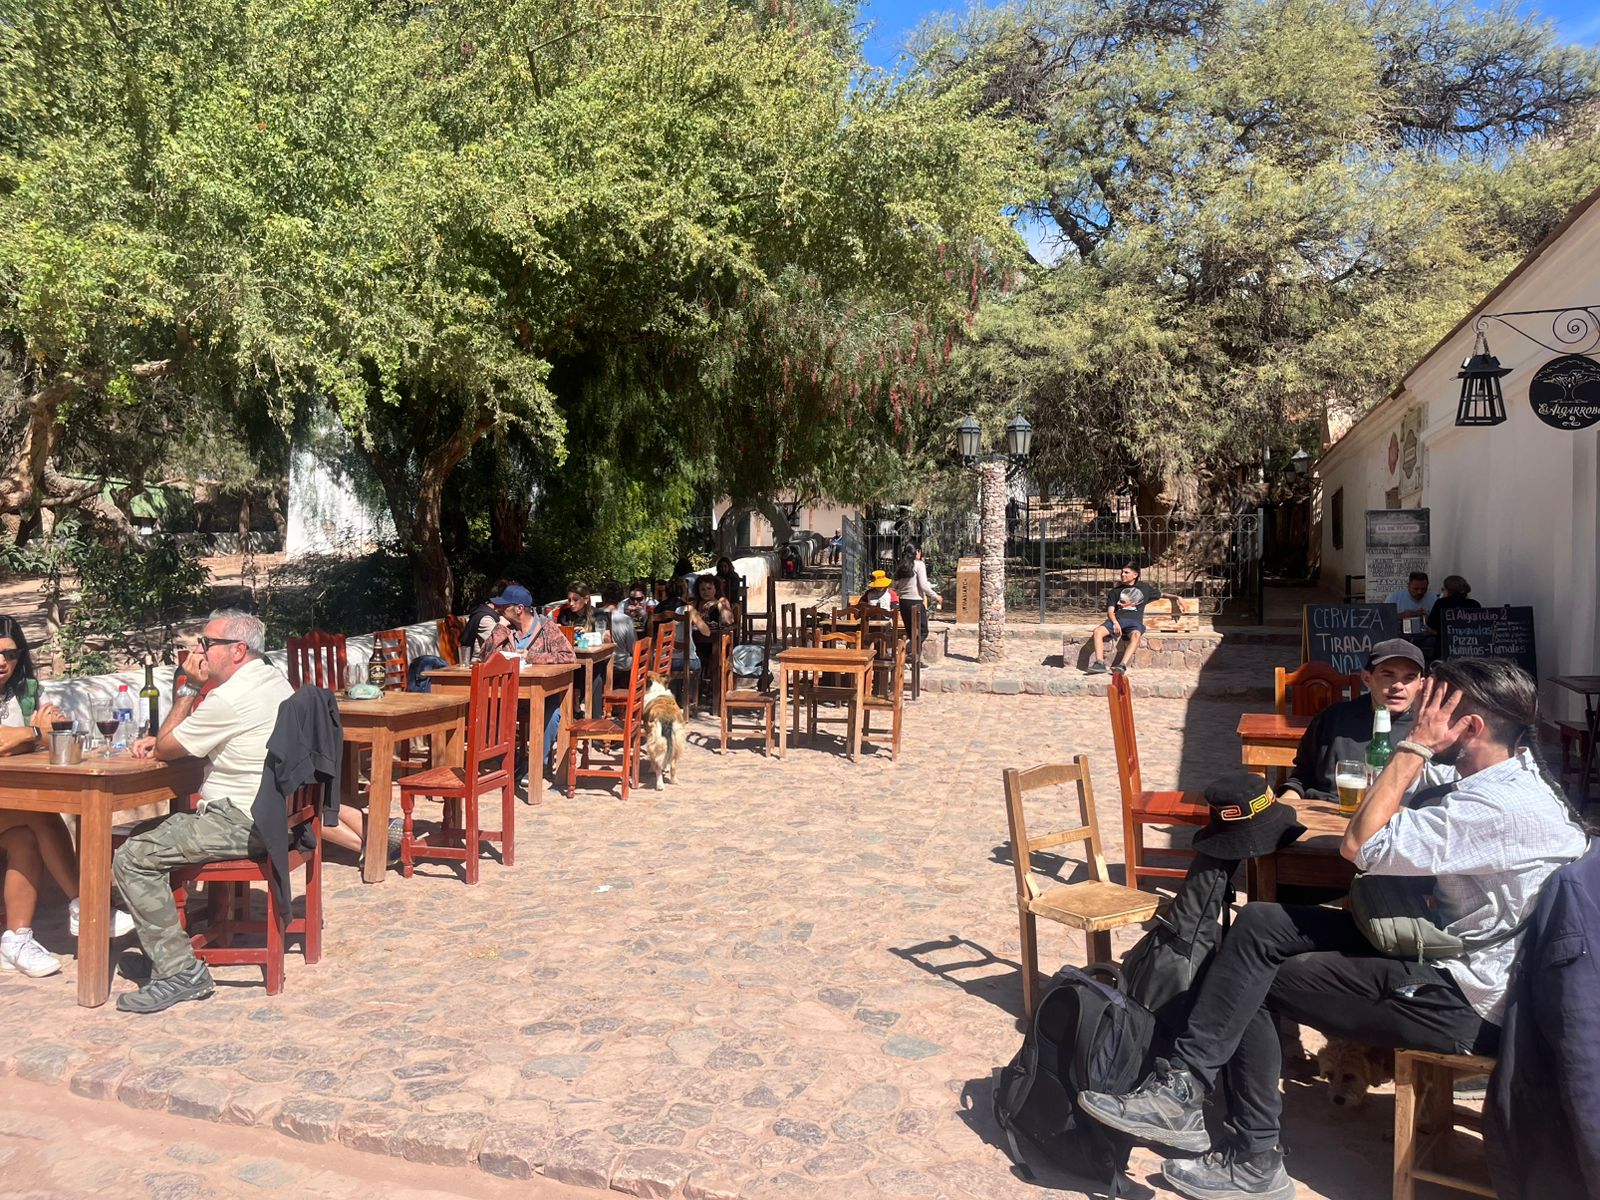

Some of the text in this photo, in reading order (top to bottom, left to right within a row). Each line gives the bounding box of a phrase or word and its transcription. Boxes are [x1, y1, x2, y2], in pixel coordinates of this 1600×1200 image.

[1562, 415, 1581, 427] 2
[1313, 607, 1384, 631] CERVEZA
[1445, 609, 1456, 621] El
[1500, 608, 1508, 620] 2
[1315, 633, 1372, 654] TIRADA
[1452, 635, 1478, 646] Pizza
